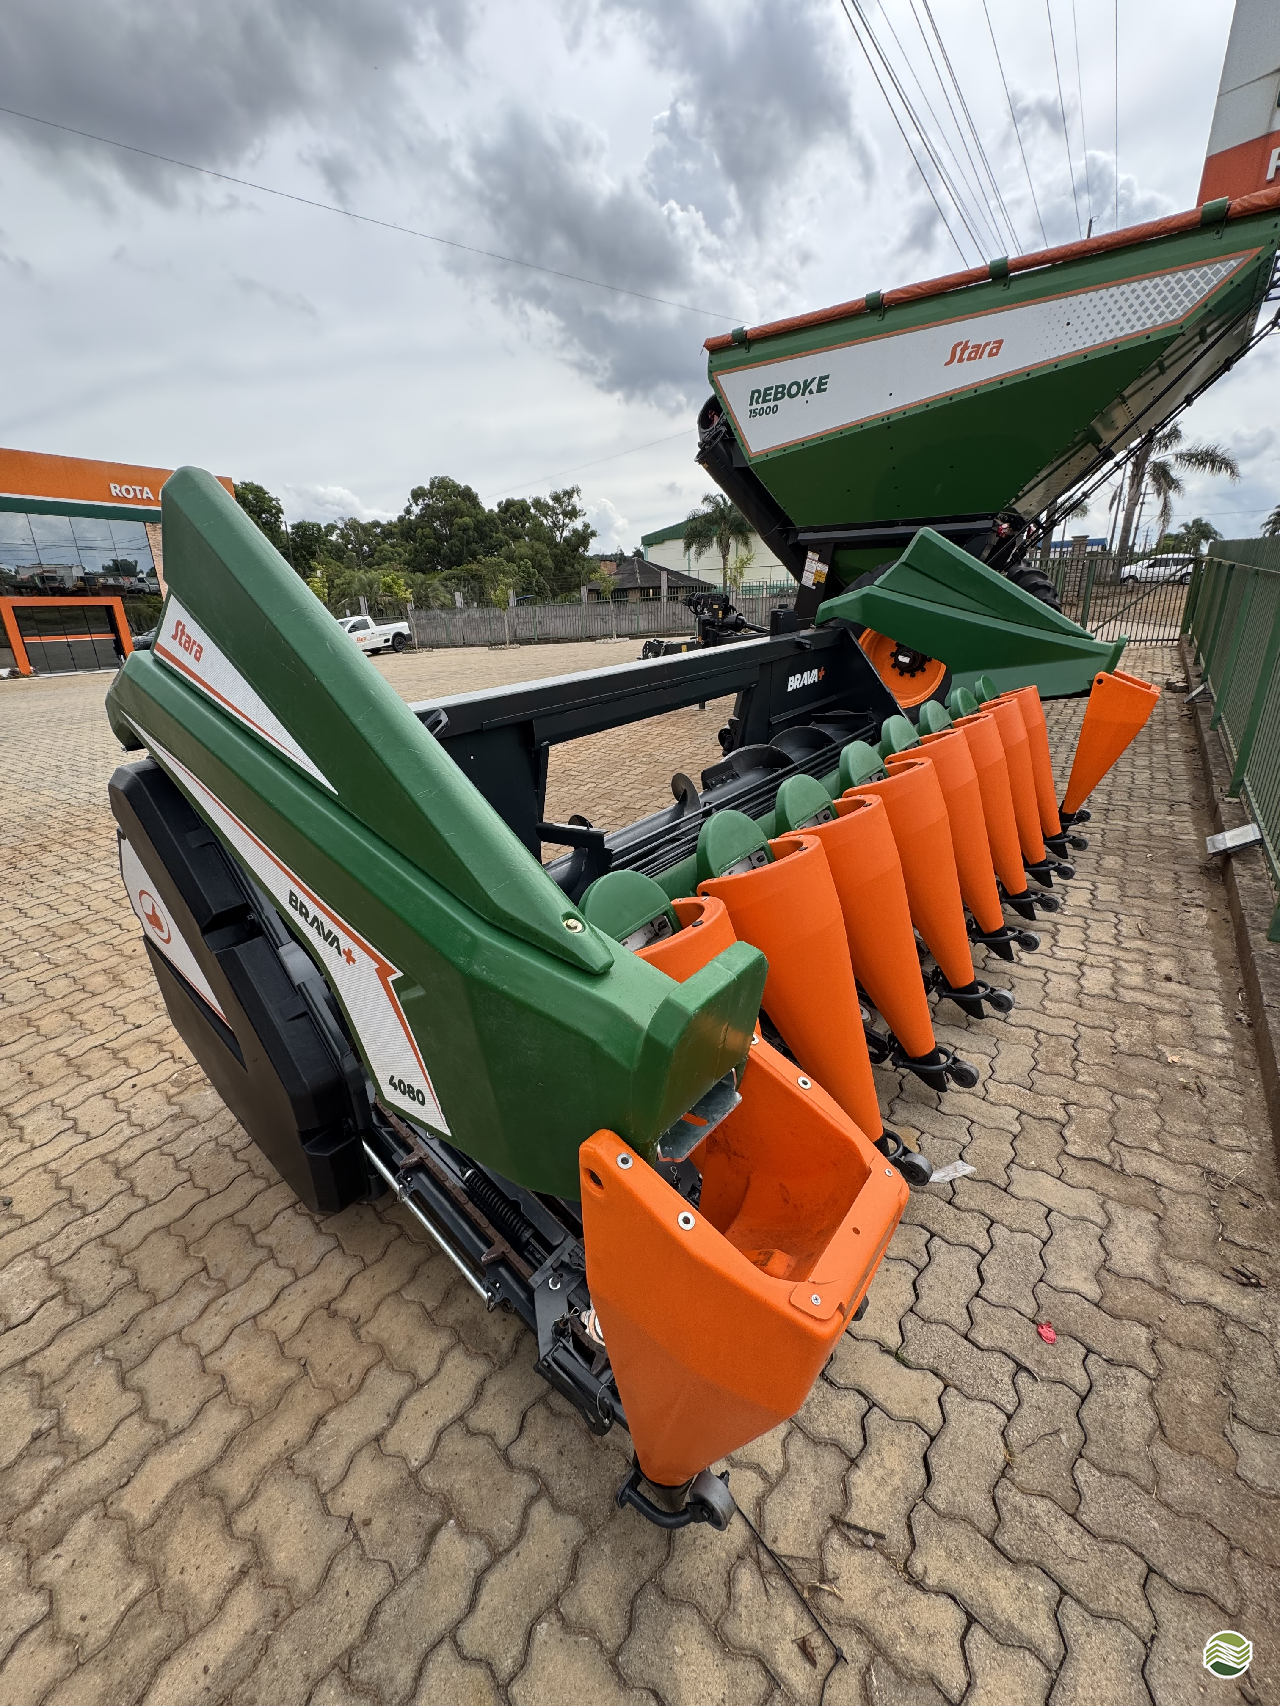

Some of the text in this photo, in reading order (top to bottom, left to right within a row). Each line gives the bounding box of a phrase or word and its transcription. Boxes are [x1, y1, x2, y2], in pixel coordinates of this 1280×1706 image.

[943, 339, 1004, 367] Stara
[749, 374, 831, 406] REBOKE
[749, 404, 779, 418] 15000
[110, 483, 155, 501] ROTA
[171, 619, 204, 663] Stara
[388, 1074, 426, 1107] 4080
